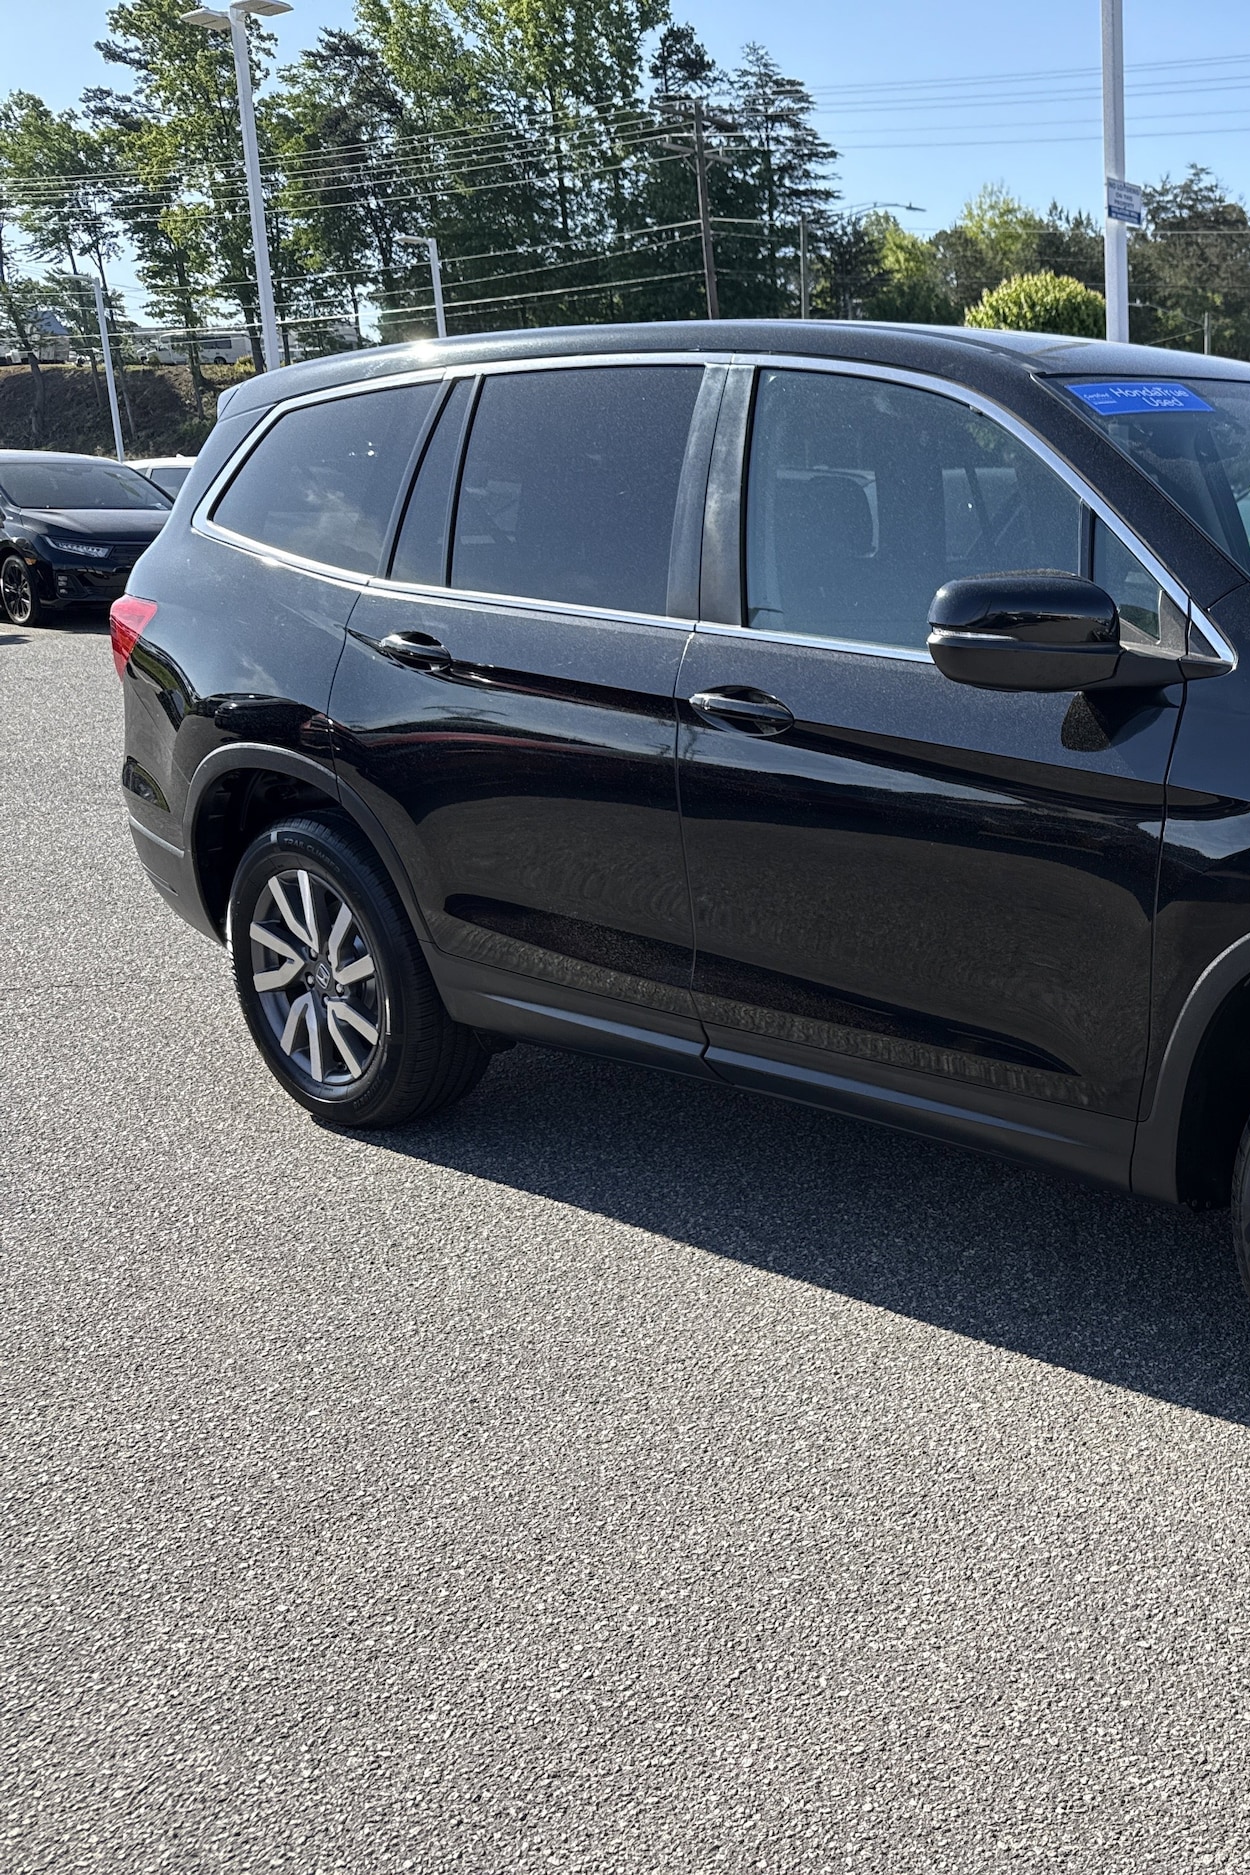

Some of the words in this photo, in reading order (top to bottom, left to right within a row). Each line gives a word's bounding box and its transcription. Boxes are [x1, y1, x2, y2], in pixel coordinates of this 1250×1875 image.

[1109, 386, 1191, 399] HondaTrue
[1142, 396, 1185, 408] Used
[283, 837, 305, 849] TRAIL
